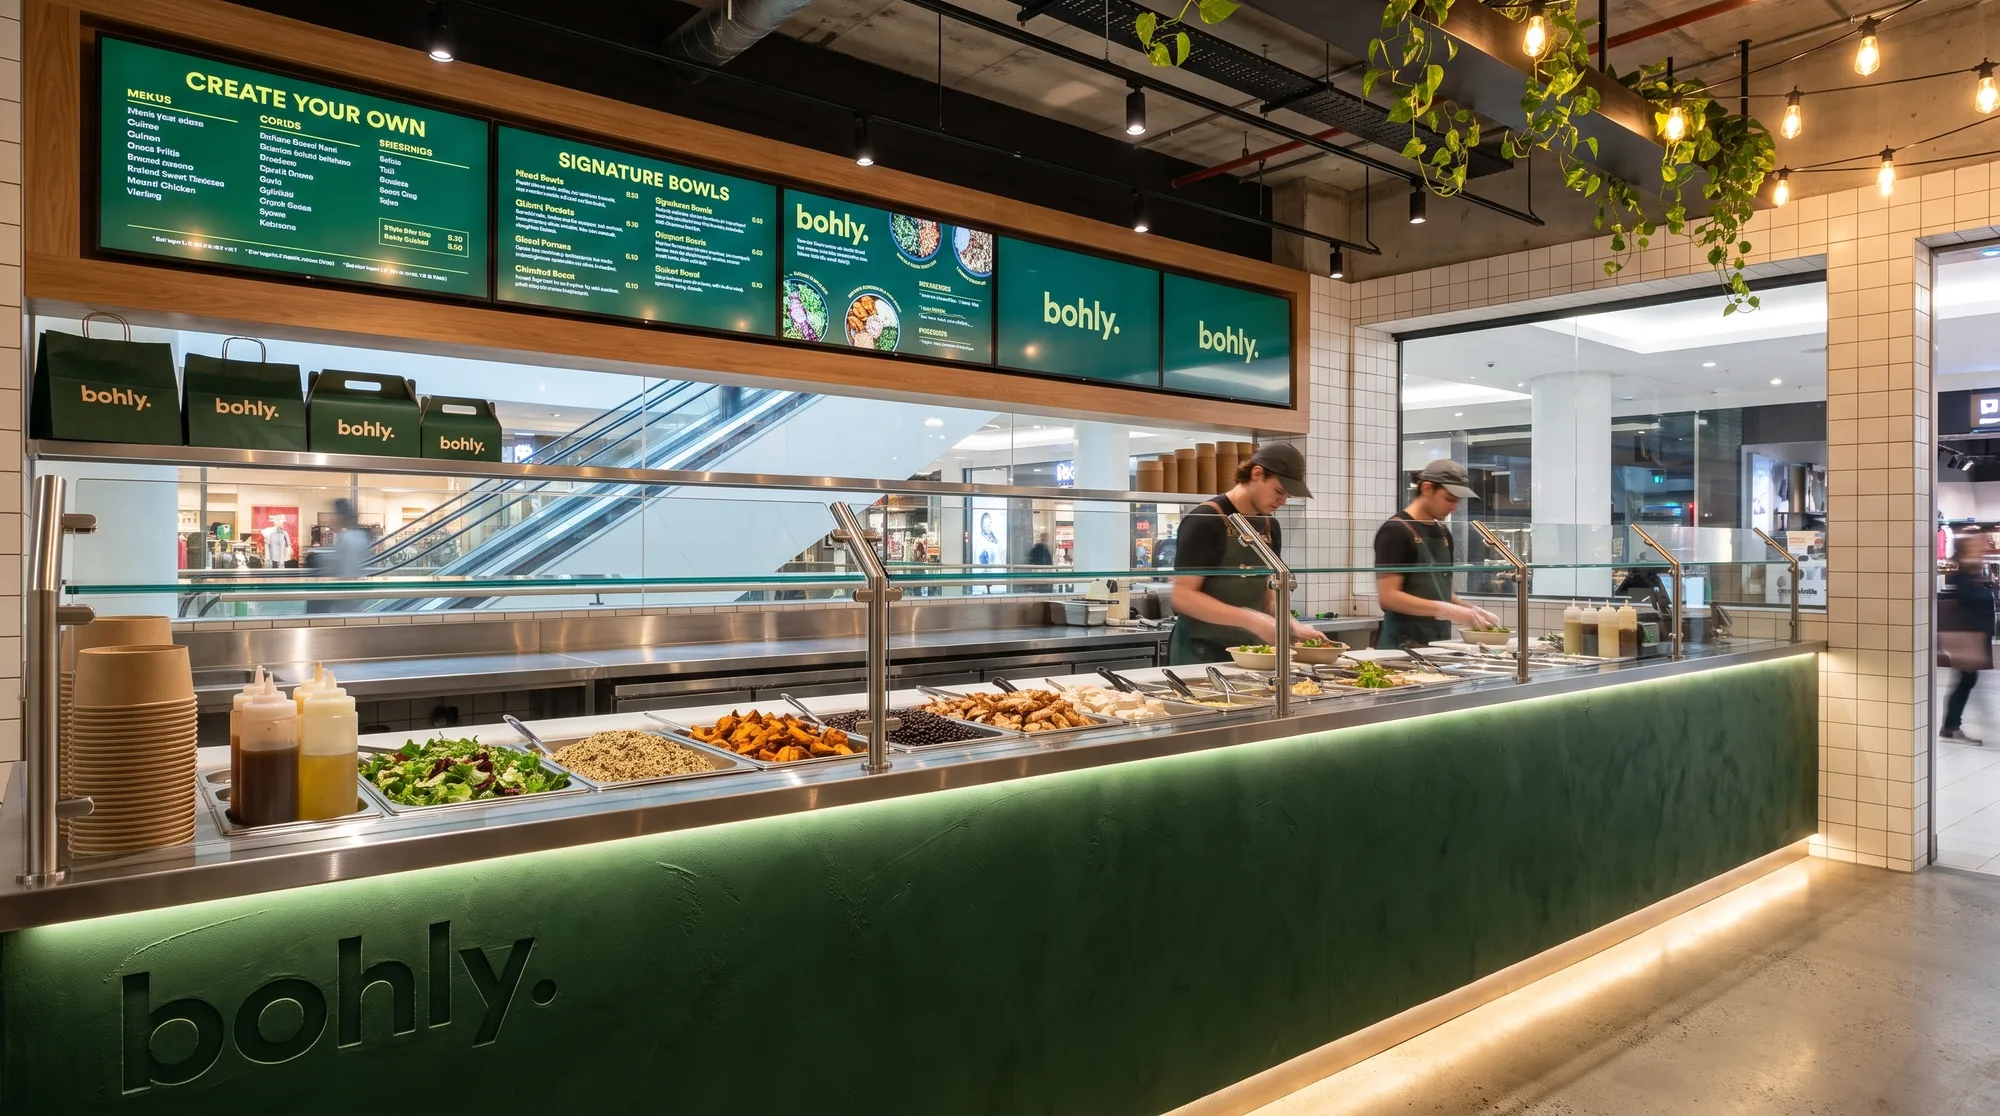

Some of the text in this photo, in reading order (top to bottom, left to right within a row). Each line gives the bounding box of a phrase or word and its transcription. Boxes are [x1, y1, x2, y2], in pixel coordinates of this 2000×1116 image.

[127, 88, 172, 105] MEKUS
[185, 71, 426, 138] CREATE YOUR OWN
[160, 181, 196, 194] Chicken
[558, 151, 730, 202] SIGNATURE BOWLS
[796, 203, 869, 246] bohly.
[1043, 291, 1120, 341] bohly.
[1199, 320, 1259, 364] bohly.
[81, 384, 152, 412] bohly.
[215, 397, 280, 421] bohly.
[337, 418, 395, 442] bohly.
[440, 436, 485, 455] bohly.
[121, 919, 558, 1096] bohly.
